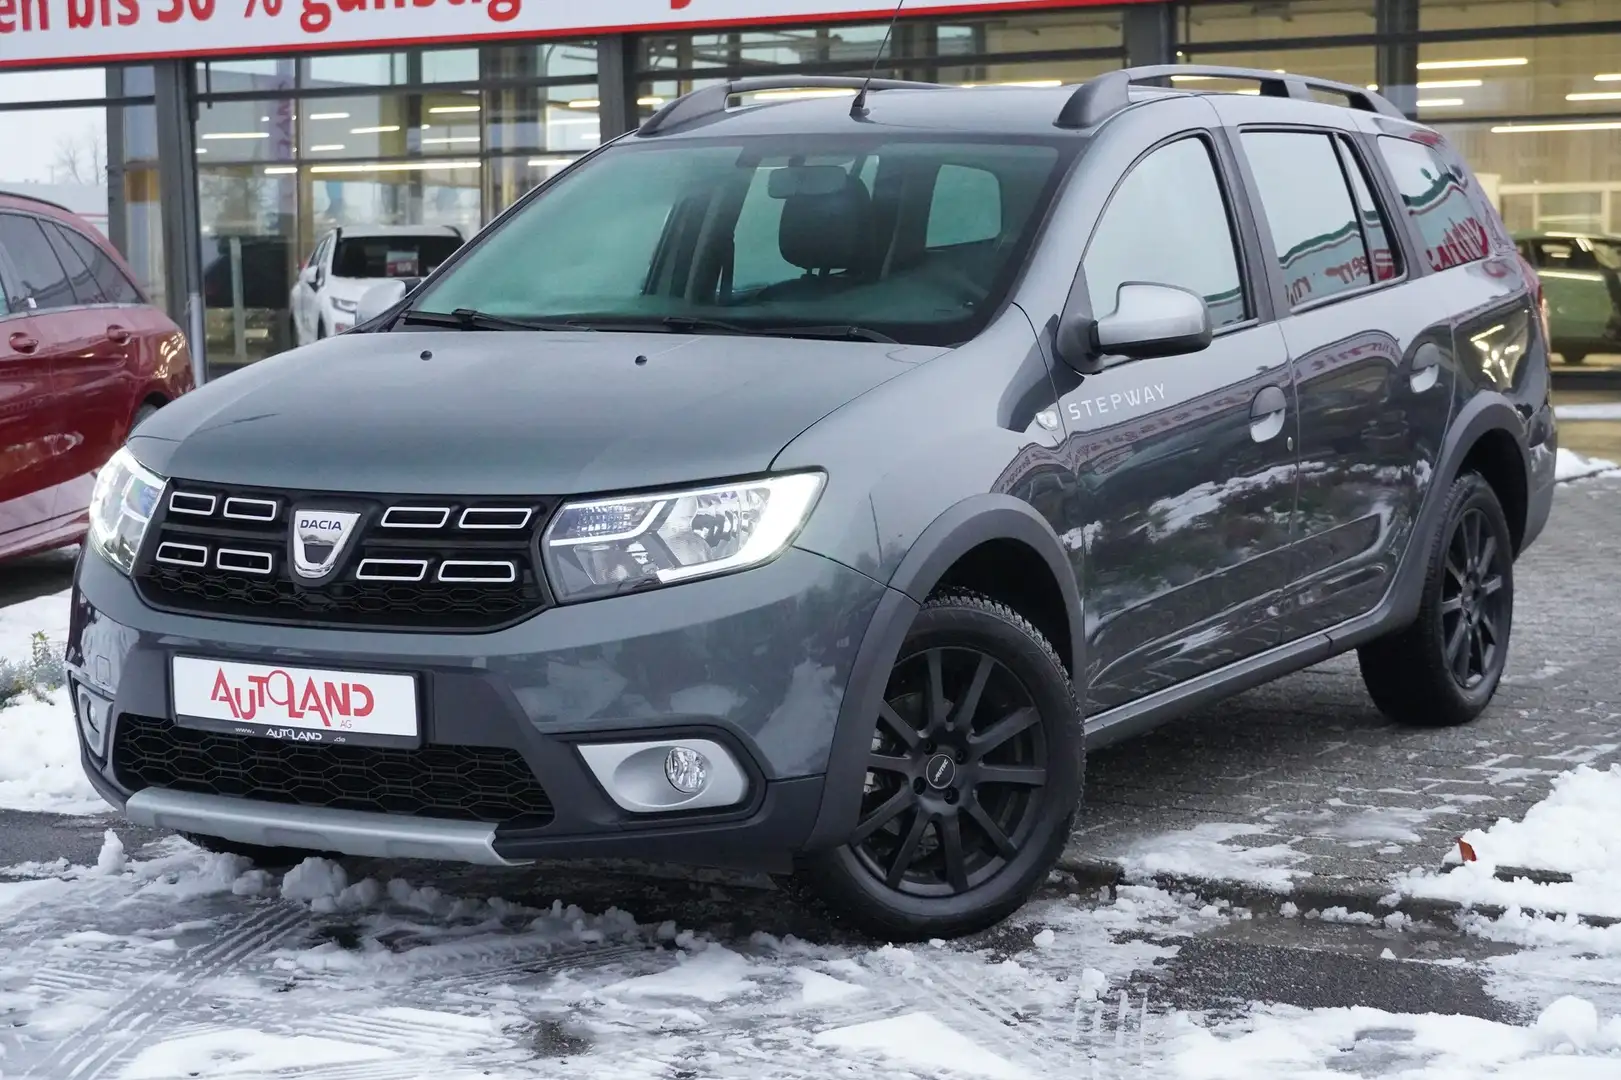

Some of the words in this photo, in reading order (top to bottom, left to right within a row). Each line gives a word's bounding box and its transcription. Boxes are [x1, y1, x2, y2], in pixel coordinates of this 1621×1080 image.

[1067, 383, 1165, 420] STEPWAY
[300, 519, 342, 531] DACIA
[210, 667, 375, 727] AUTOLAND
[339, 719, 352, 729] AG
[234, 726, 255, 735] www.
